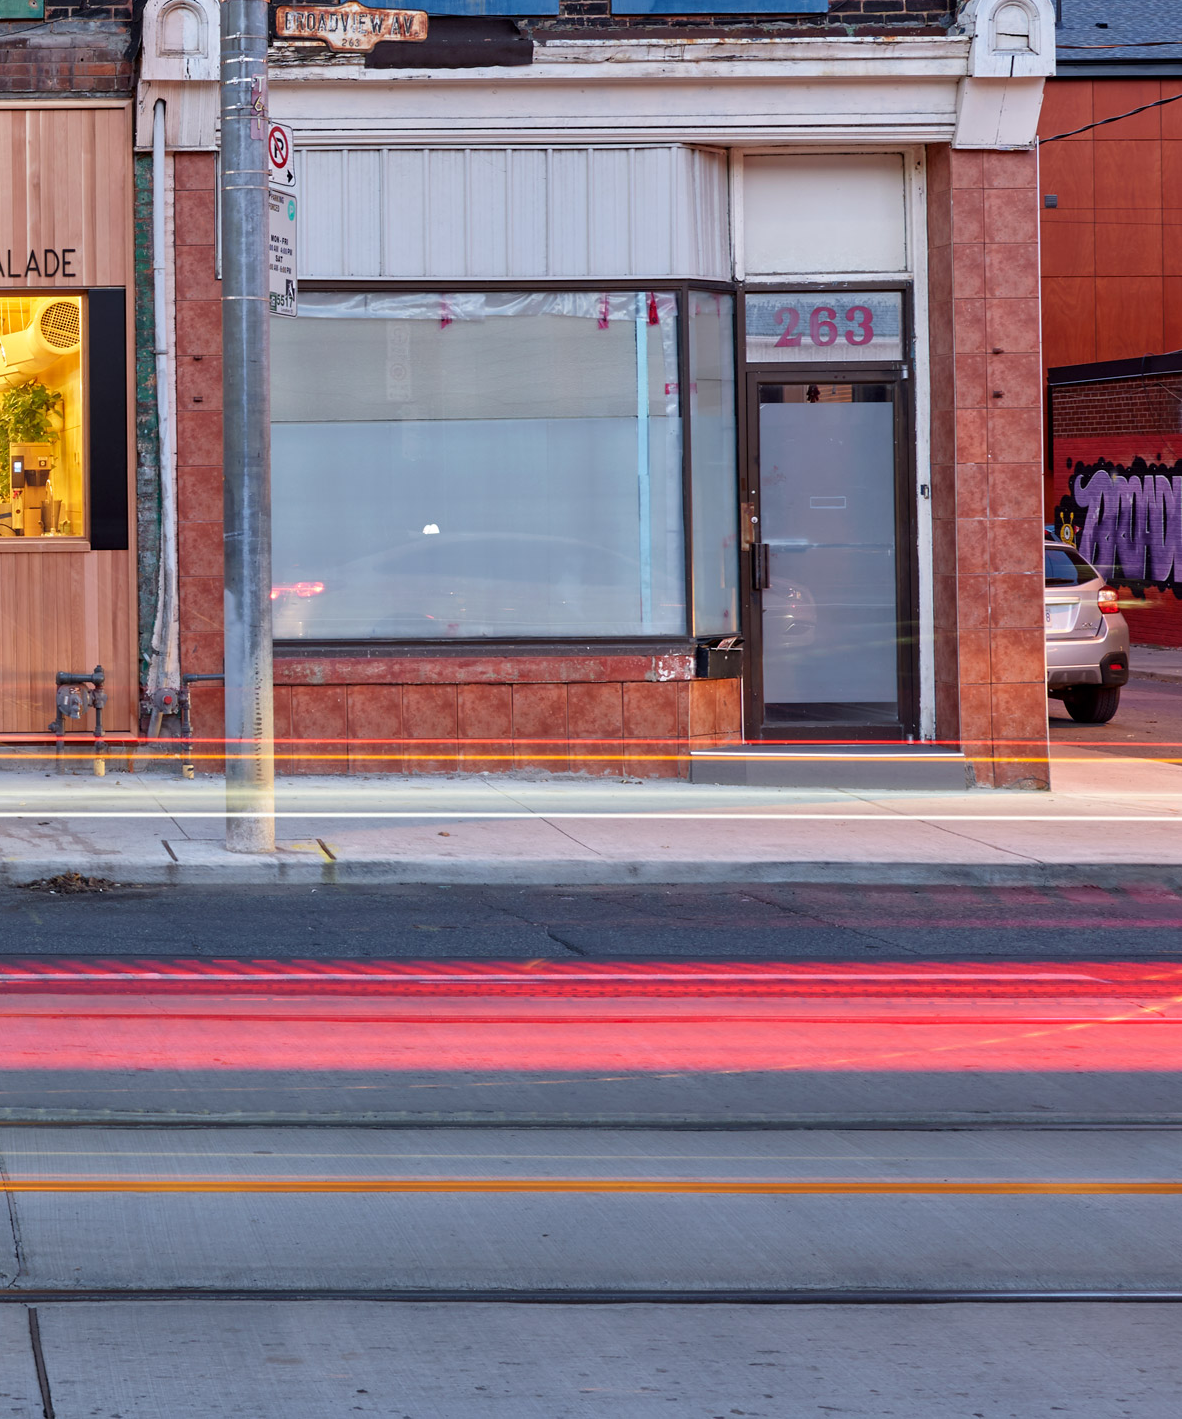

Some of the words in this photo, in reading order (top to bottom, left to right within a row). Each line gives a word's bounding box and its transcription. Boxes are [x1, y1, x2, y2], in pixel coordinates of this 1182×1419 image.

[284, 11, 383, 35] BROADVIEW
[341, 38, 360, 47] 263
[276, 293, 293, 308] 5517
[774, 305, 874, 348] 263
